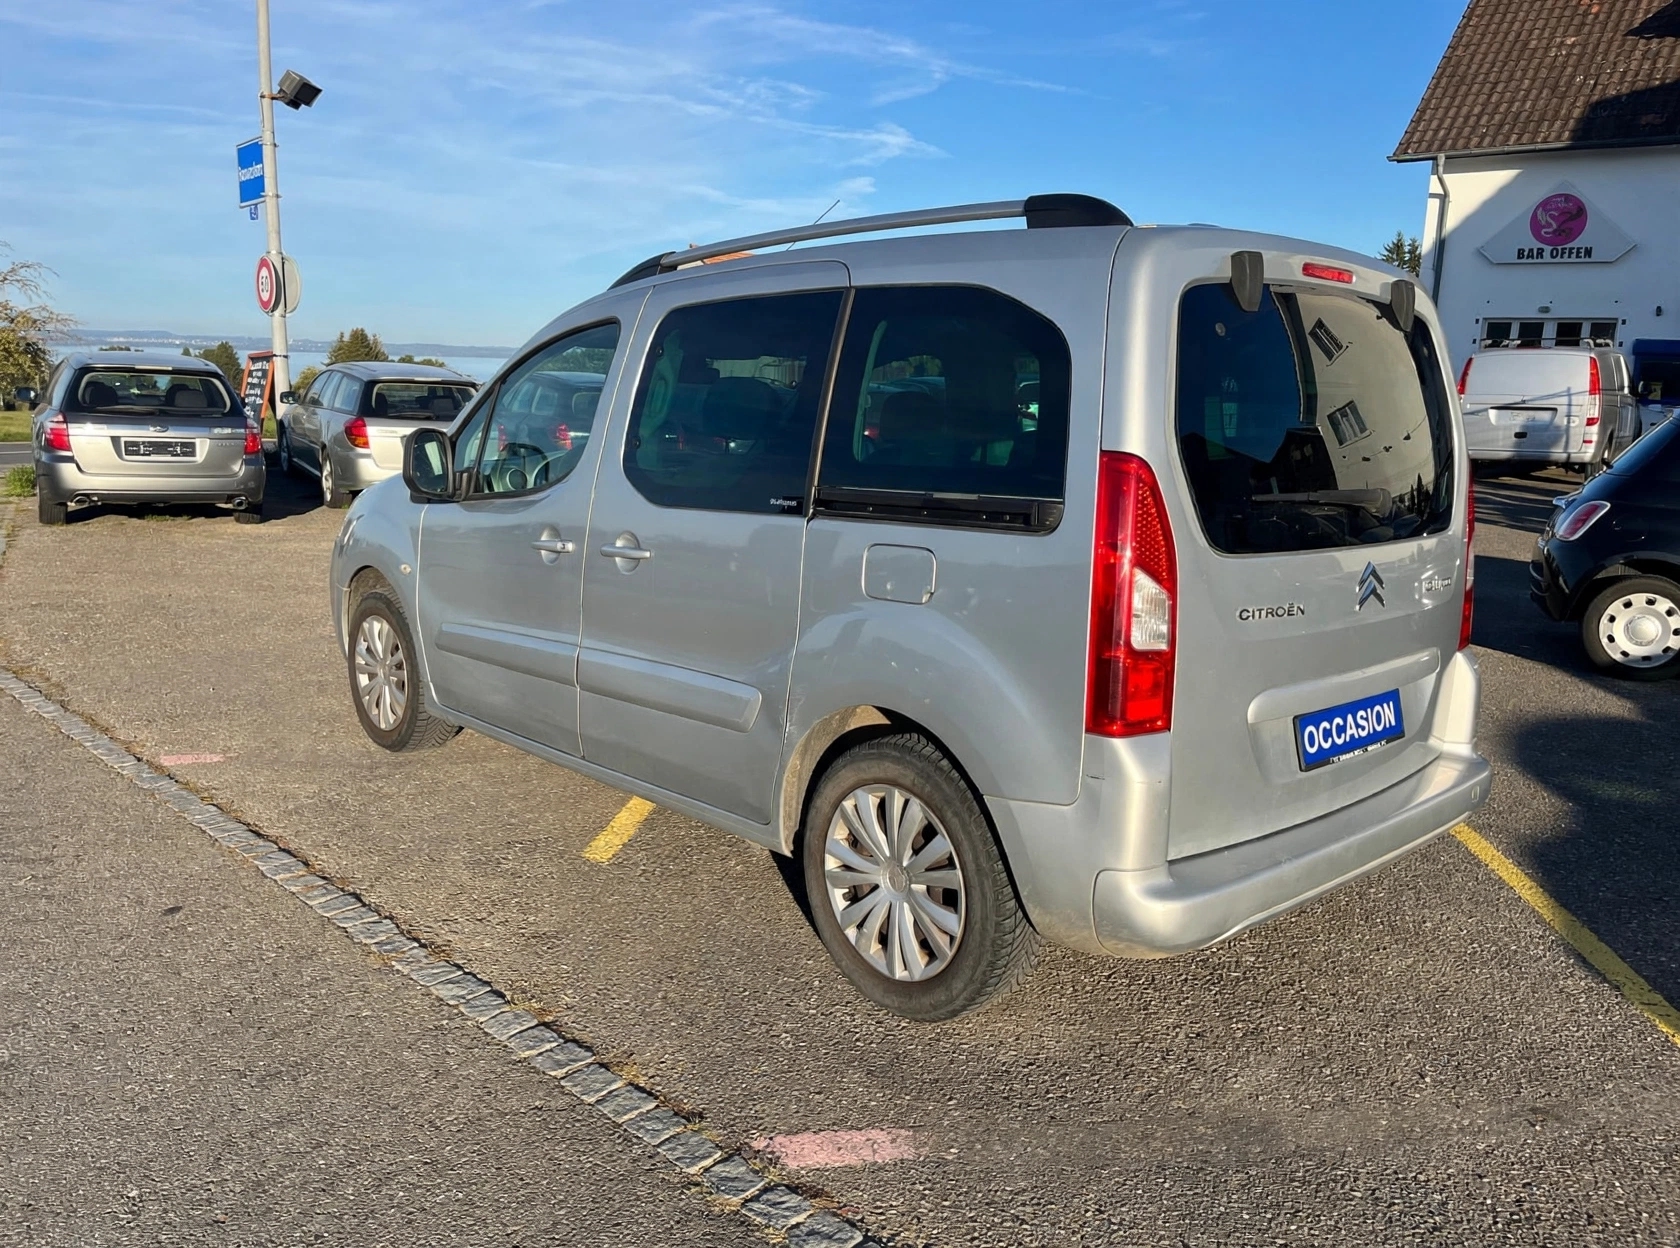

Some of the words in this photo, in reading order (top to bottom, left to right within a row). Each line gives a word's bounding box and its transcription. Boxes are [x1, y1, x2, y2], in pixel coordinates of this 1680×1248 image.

[1517, 247, 1545, 260] BAR
[1549, 246, 1593, 260] OFFEN
[261, 275, 270, 293] 50
[1238, 602, 1305, 621] CITROËN
[1303, 700, 1396, 754] OCCASION
